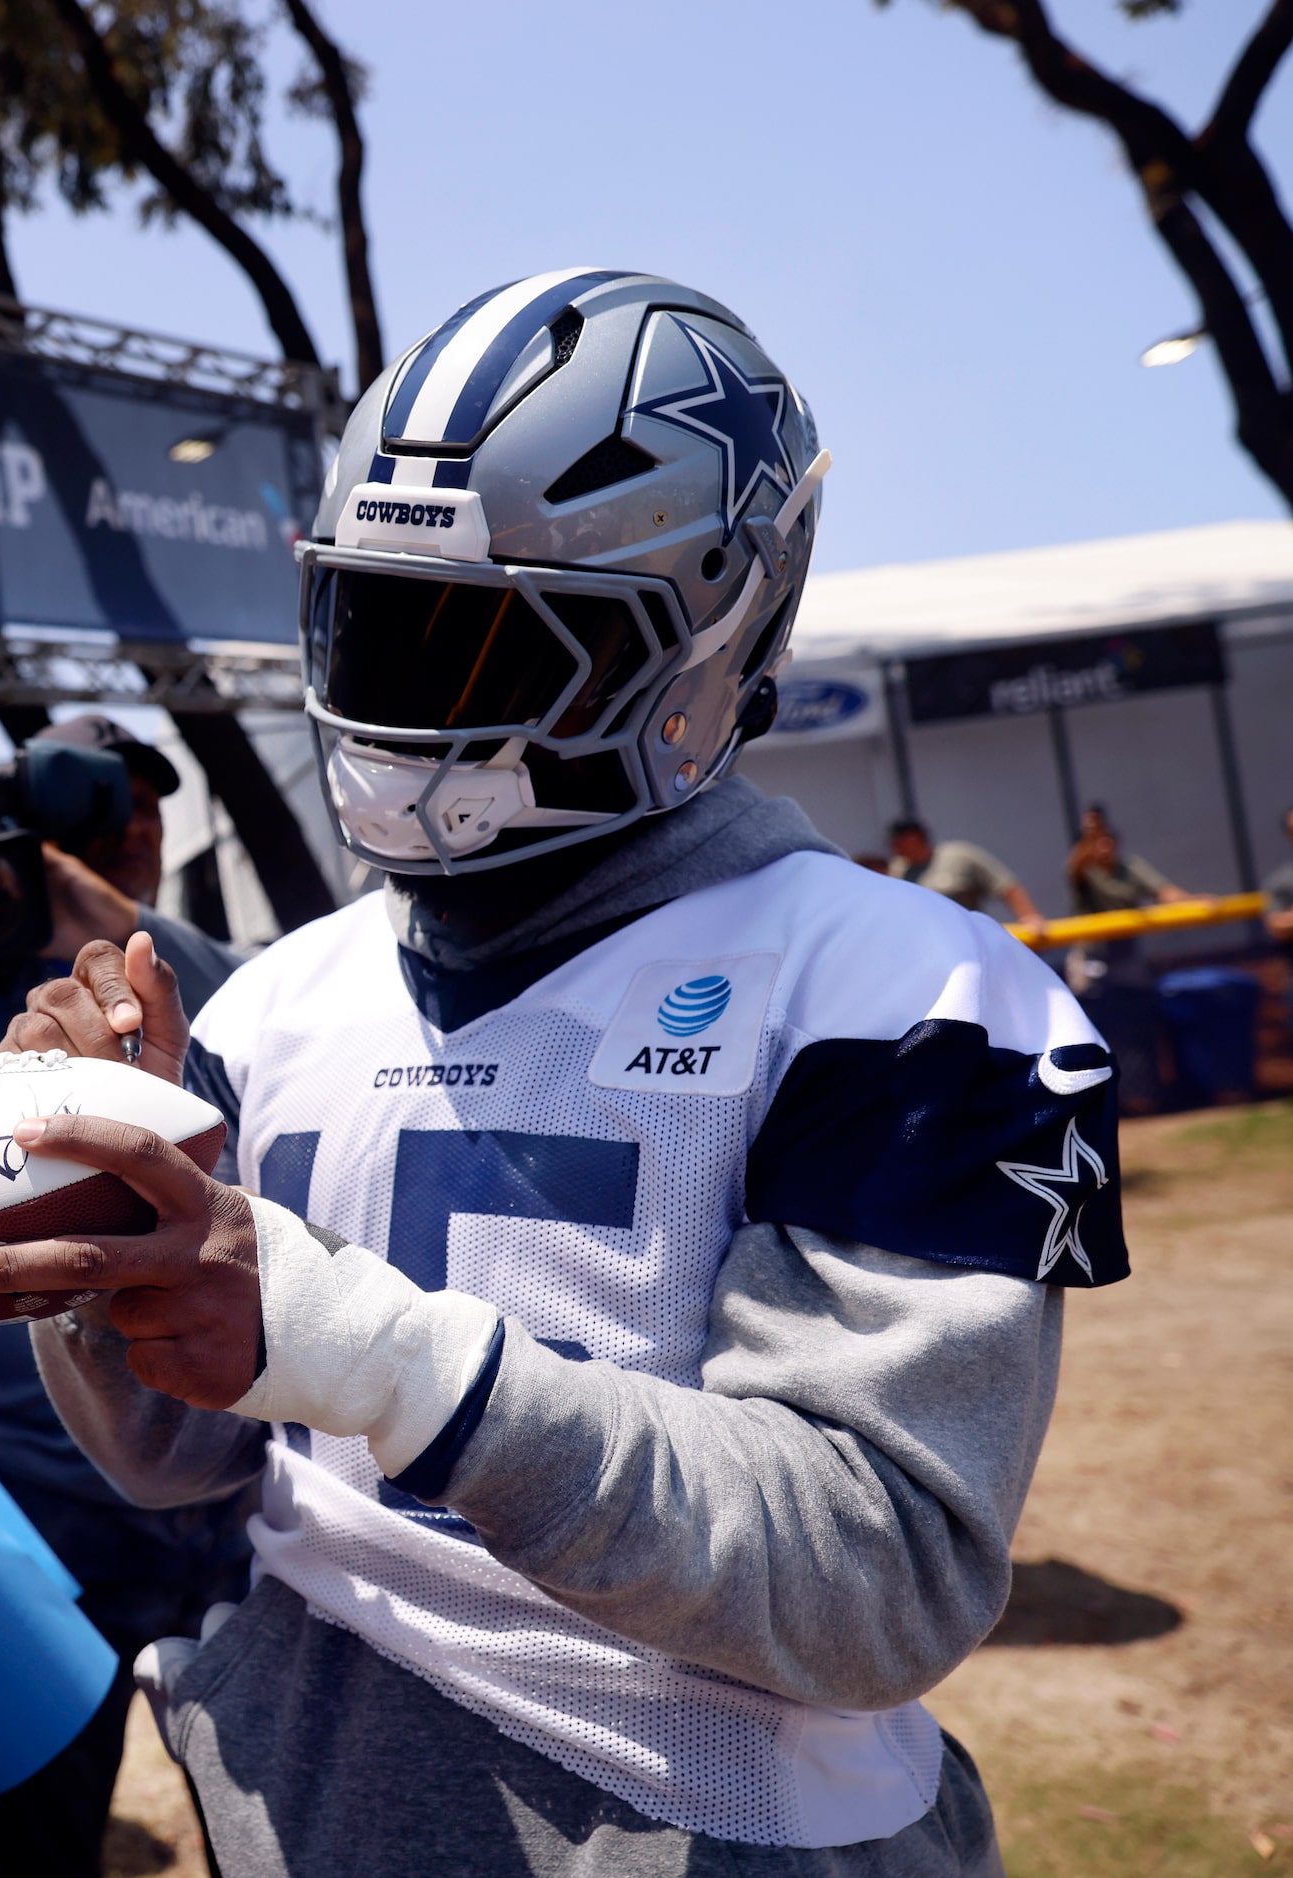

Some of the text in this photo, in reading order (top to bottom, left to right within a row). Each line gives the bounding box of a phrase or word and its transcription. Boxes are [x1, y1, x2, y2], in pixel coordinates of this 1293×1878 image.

[87, 477, 267, 549] American
[356, 499, 456, 529] COWBOYS
[990, 660, 1119, 713] reliant
[625, 1046, 721, 1075] AT&T
[373, 1063, 499, 1089] COWBOYS
